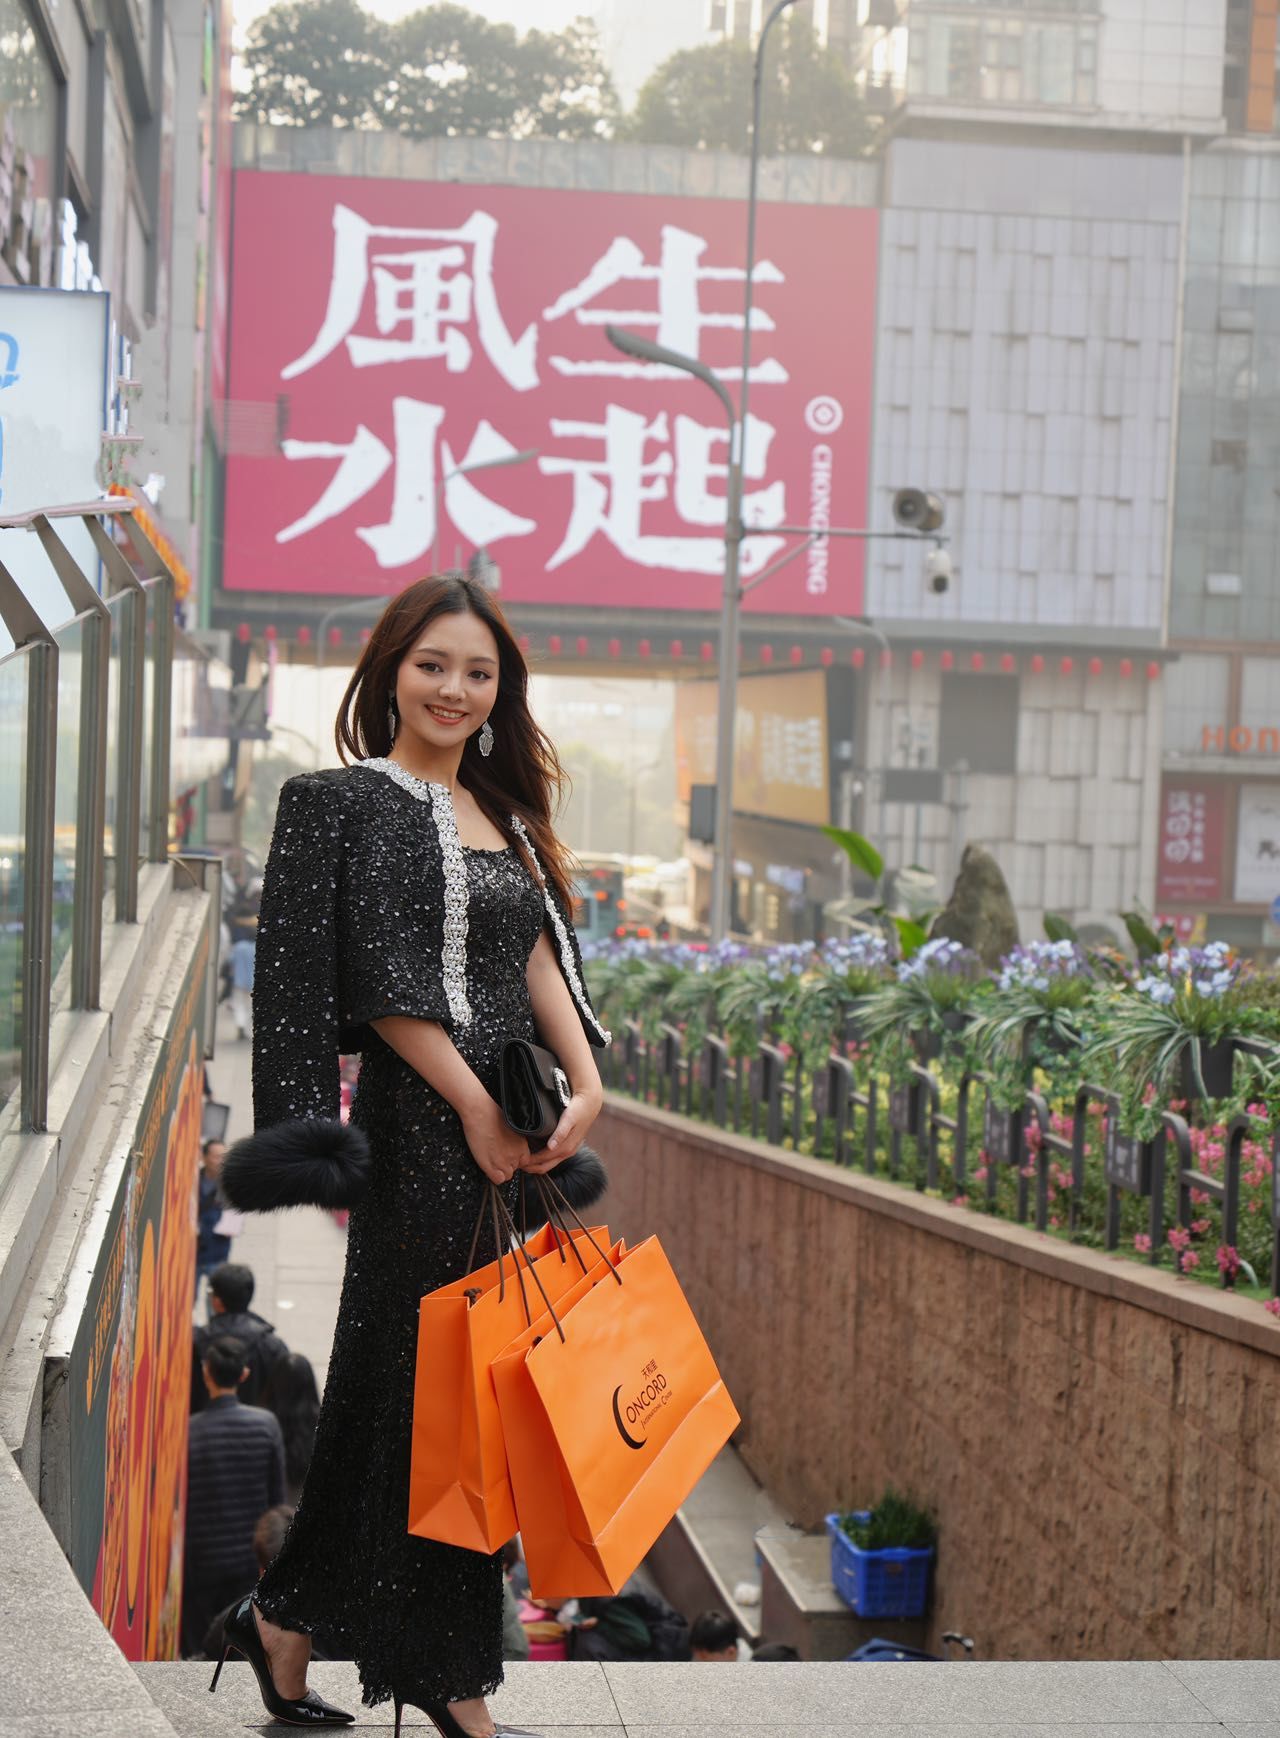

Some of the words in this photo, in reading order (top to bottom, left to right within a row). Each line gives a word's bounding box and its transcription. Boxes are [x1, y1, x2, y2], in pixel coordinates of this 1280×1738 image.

[280, 203, 789, 392] 風生
[275, 395, 785, 576] 水起
[612, 1373, 667, 1450] CONCORD
